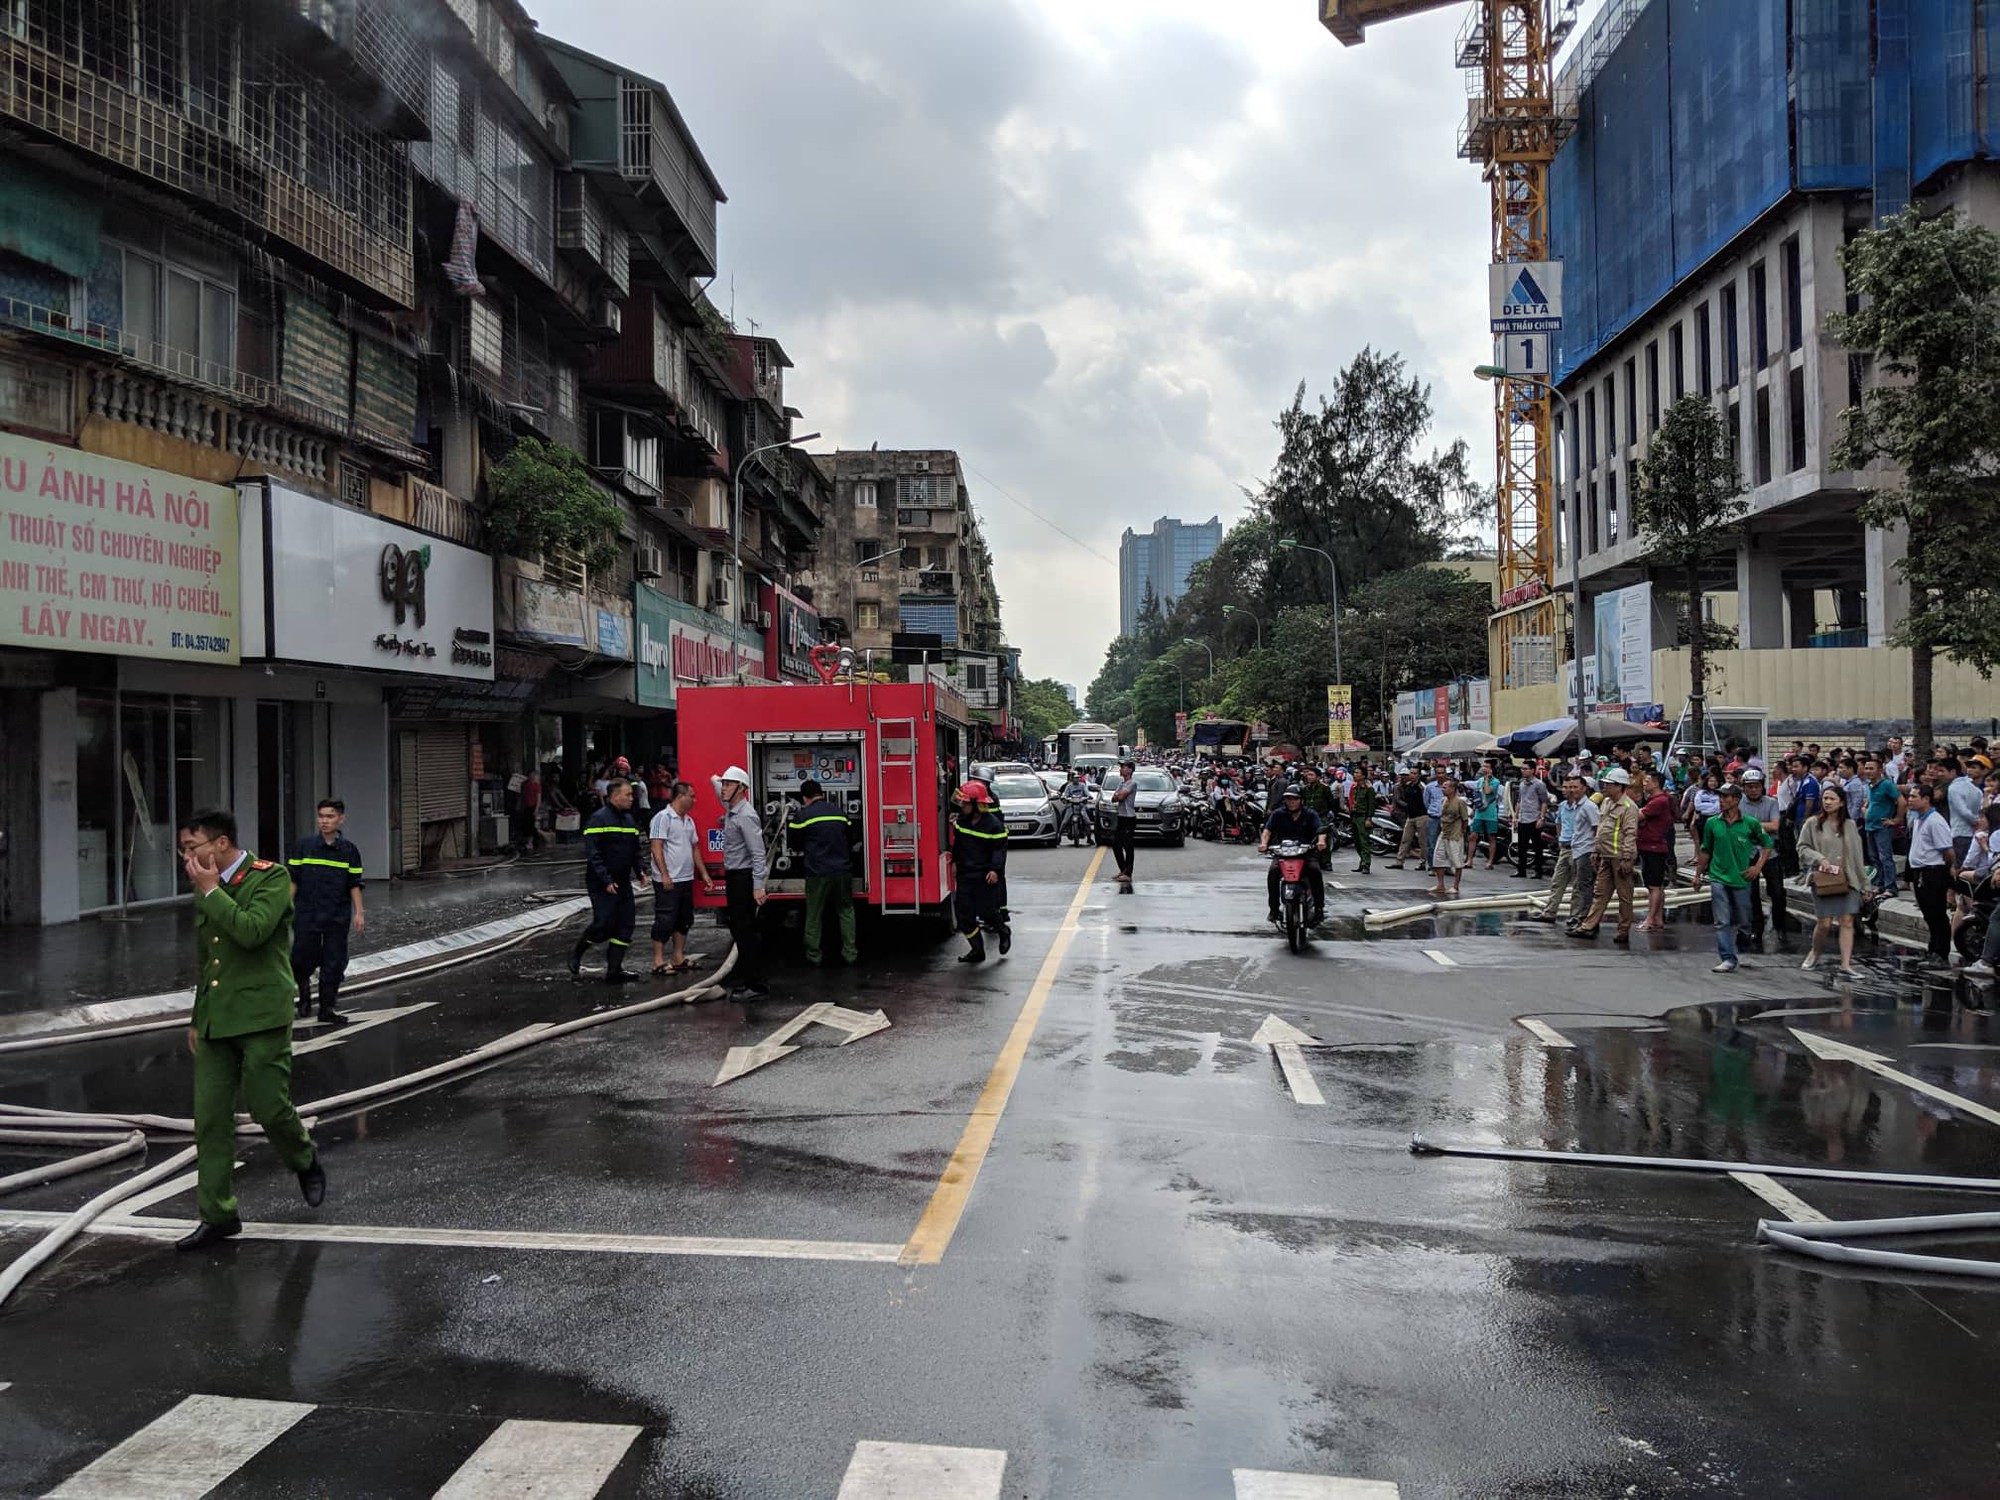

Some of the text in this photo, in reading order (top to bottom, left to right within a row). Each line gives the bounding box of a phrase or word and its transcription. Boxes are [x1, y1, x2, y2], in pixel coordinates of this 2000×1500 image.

[1502, 304, 1549, 315] DELTA
[1534, 319, 1560, 330] CHÍNH
[1520, 338, 1534, 369] 1
[39, 452, 106, 509] ẢNH
[115, 479, 156, 519] HÀ
[164, 490, 210, 538] NỘI
[8, 512, 222, 579] THUẬT SỐ CHUYÊN NGHIỆP
[80, 571, 107, 601] CM
[152, 578, 173, 614] HỘ
[21, 598, 153, 647] LẤY NGAY.
